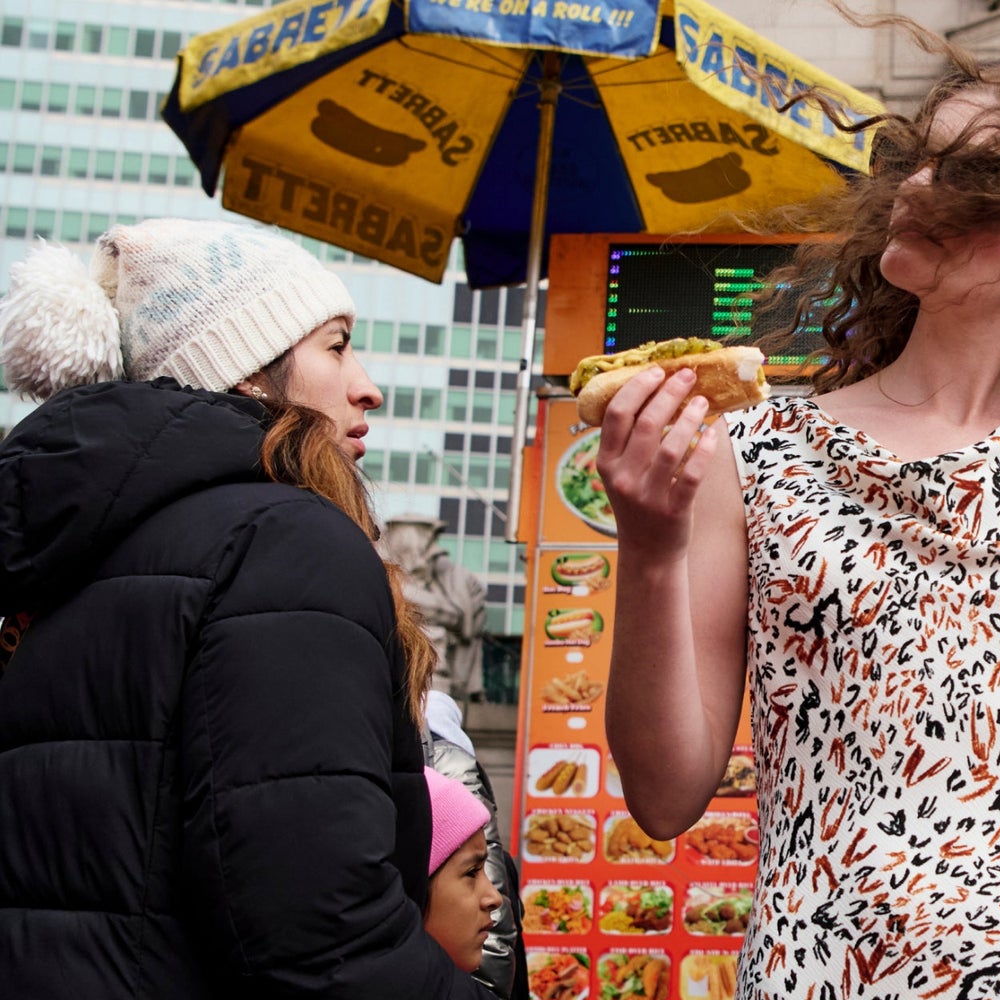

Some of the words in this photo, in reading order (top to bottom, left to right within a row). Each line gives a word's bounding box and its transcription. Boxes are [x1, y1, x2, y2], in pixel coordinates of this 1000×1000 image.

[498, 0, 529, 15] ON
[532, 1, 548, 17] A
[552, 2, 602, 23] ROLL
